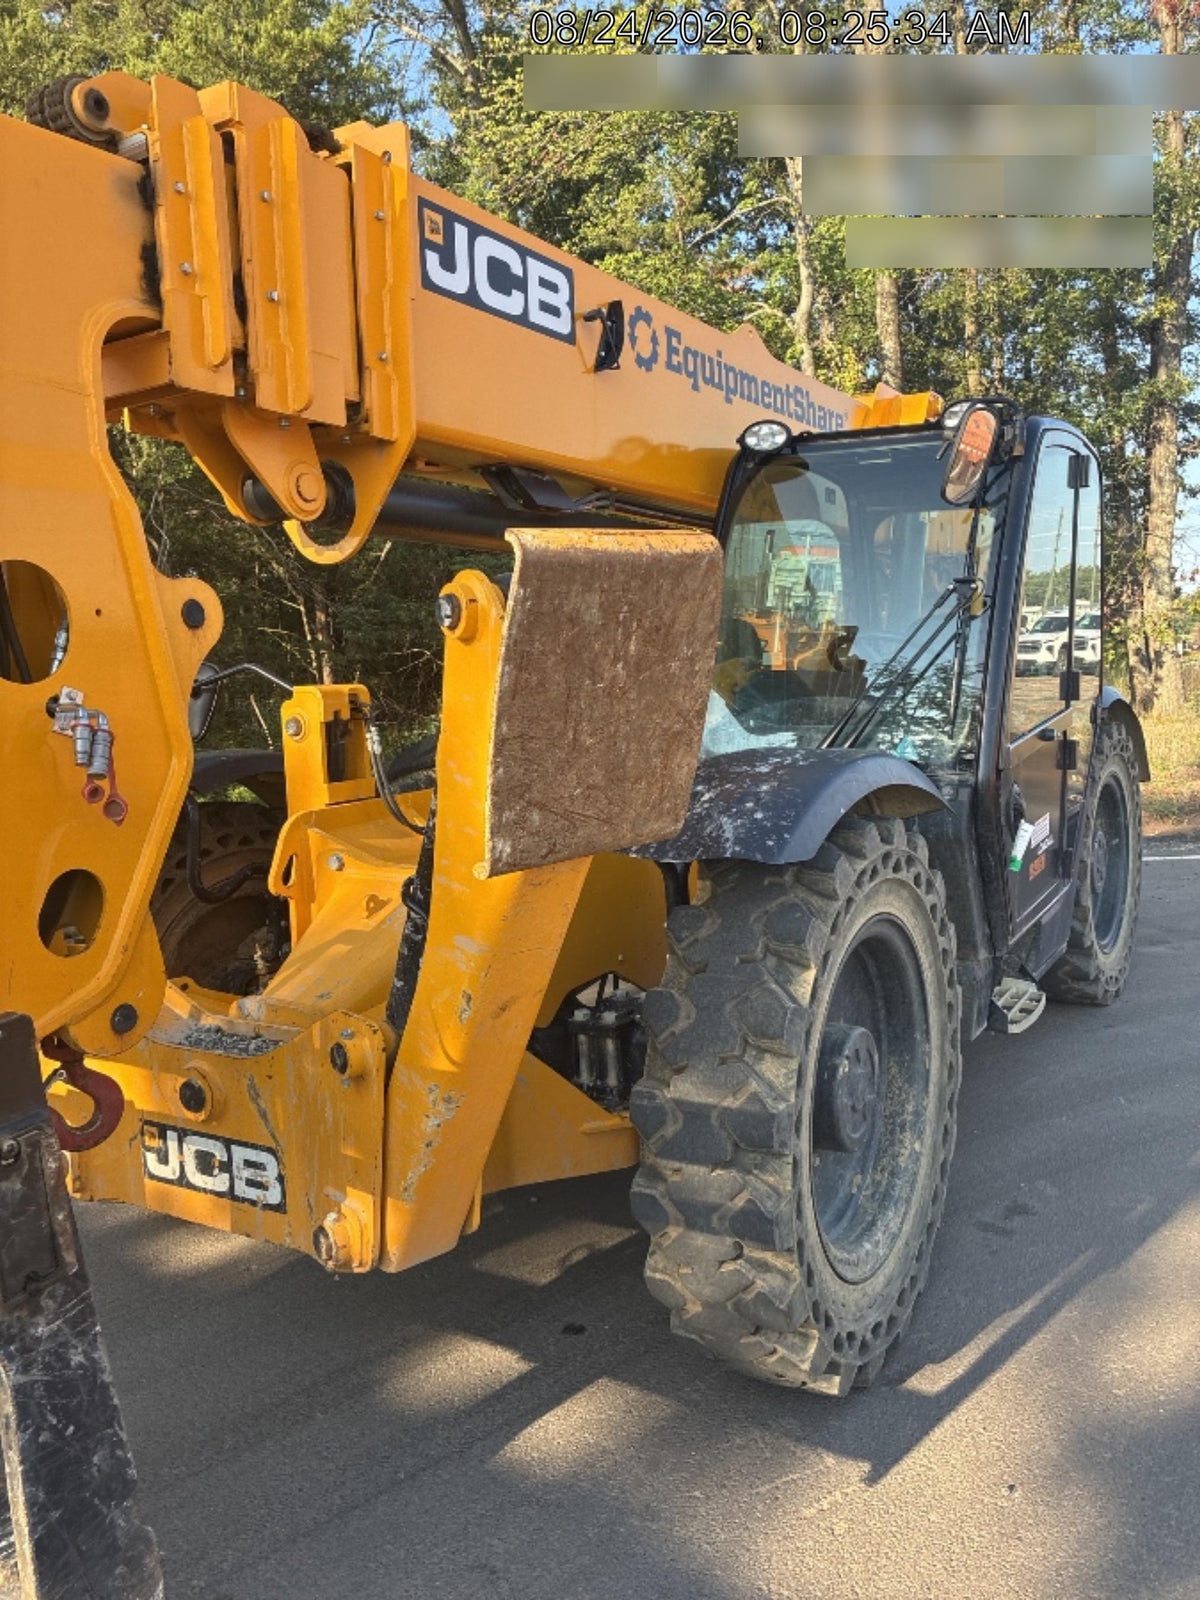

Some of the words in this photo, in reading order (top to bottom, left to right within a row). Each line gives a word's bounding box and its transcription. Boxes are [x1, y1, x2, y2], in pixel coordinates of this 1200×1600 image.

[424, 221, 573, 335] JCB
[665, 325, 843, 432] EquipmentShare
[145, 1130, 282, 1204] JCB
